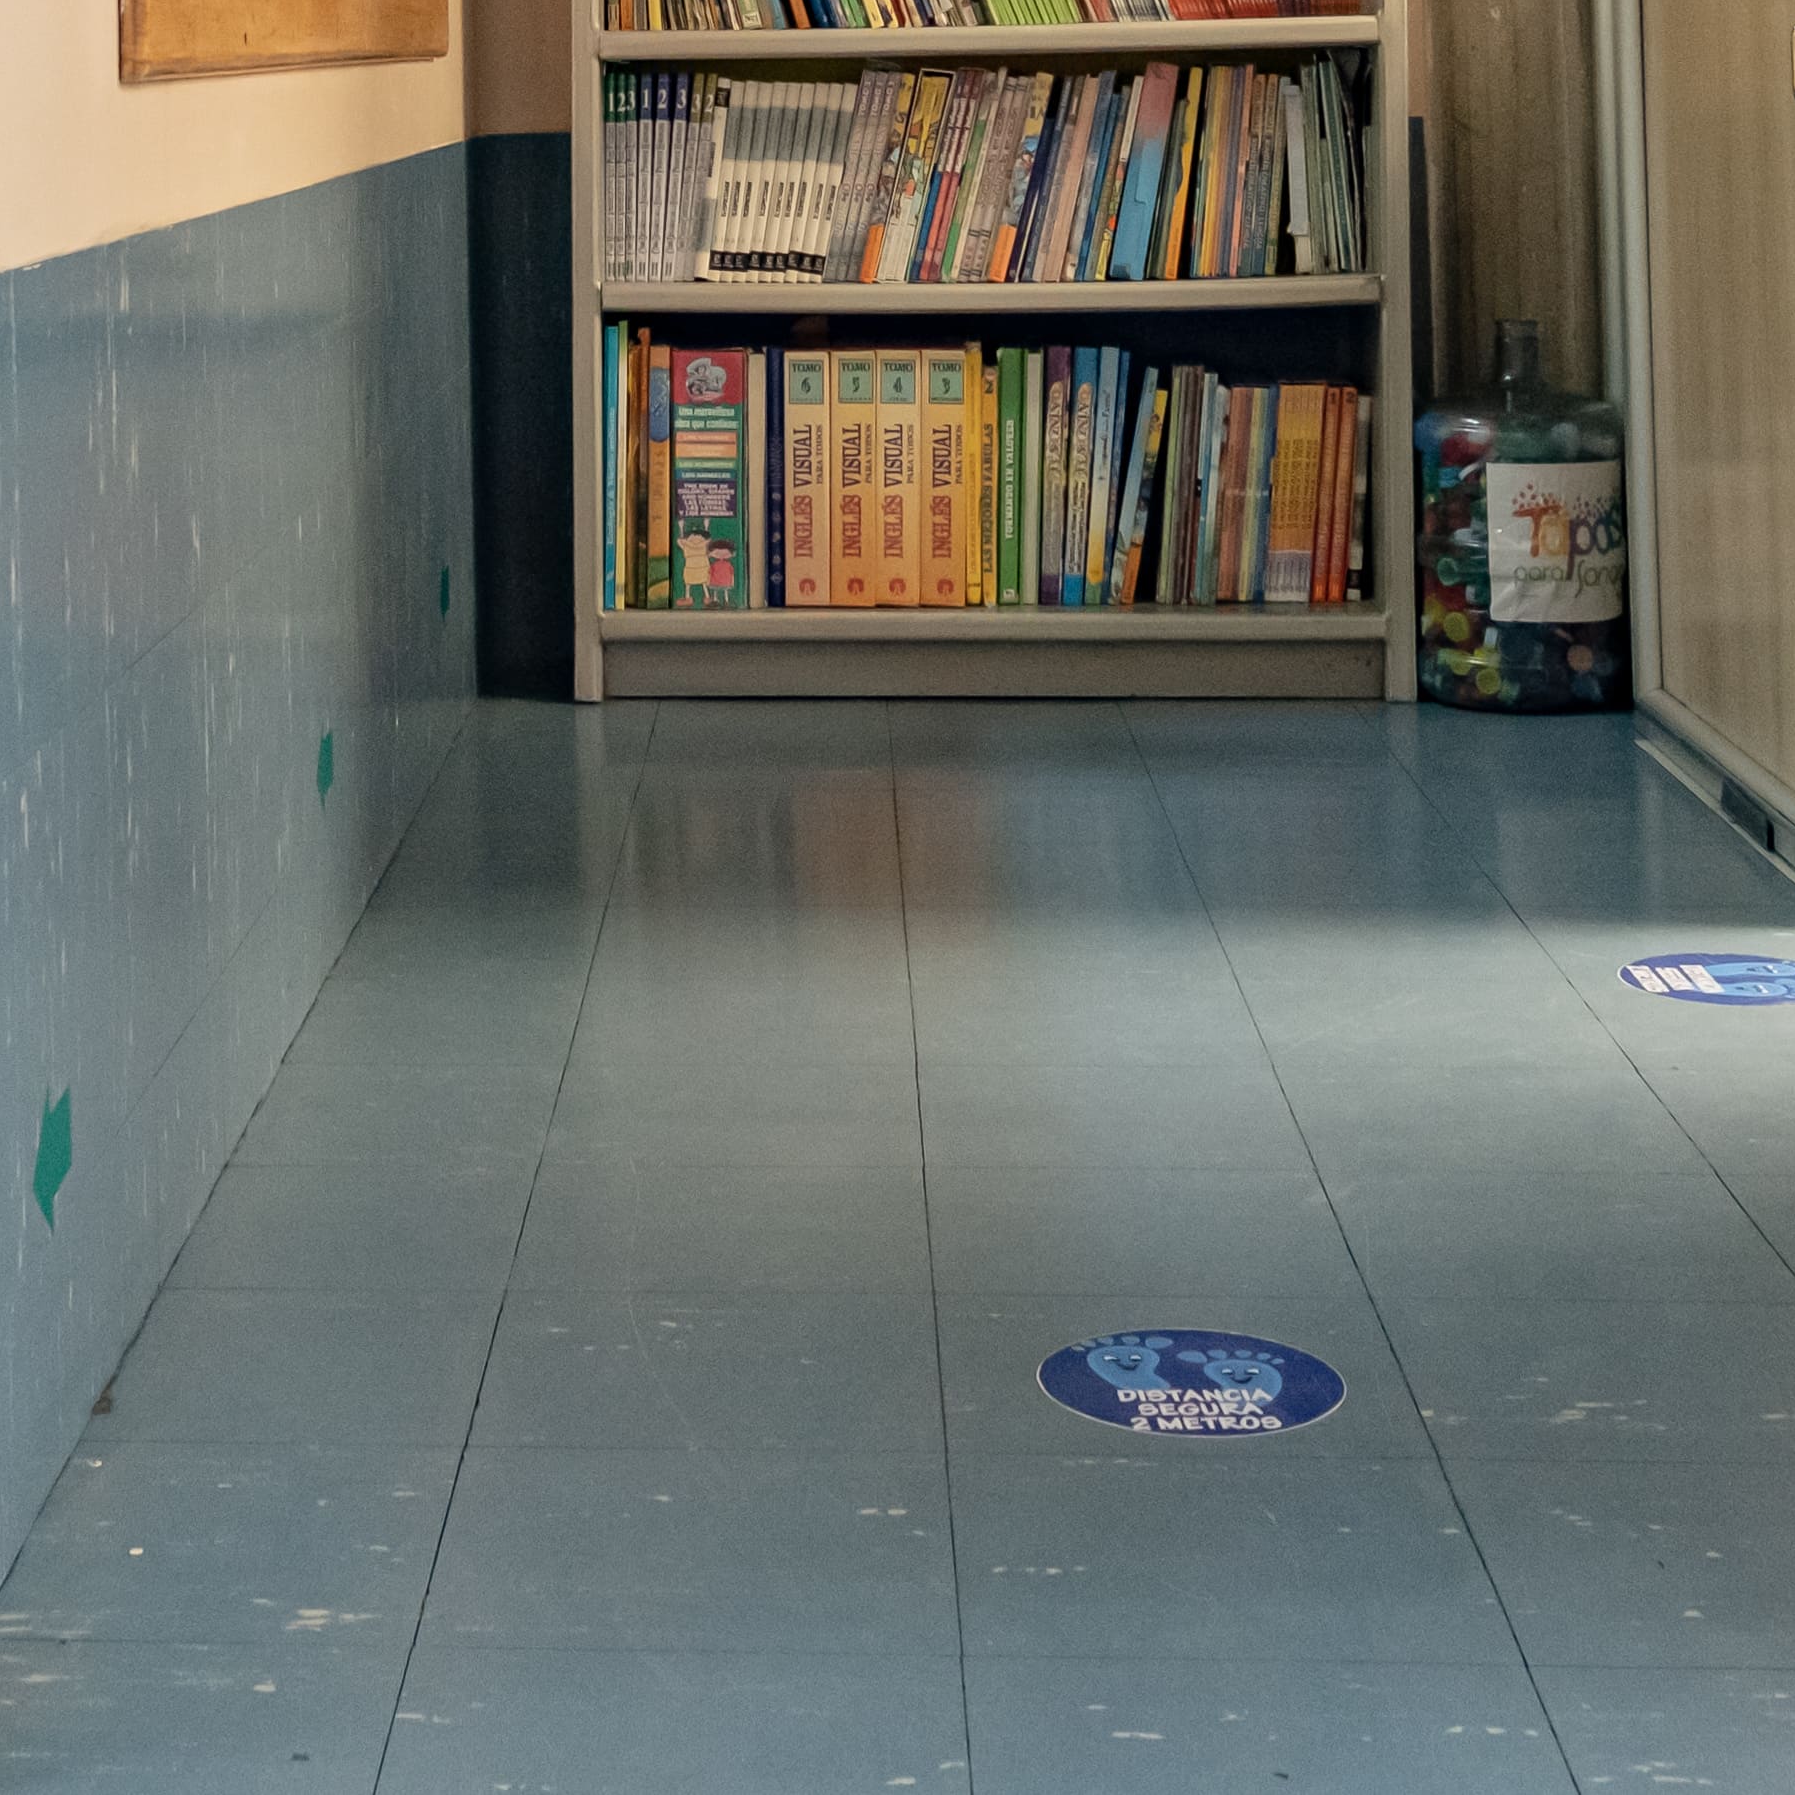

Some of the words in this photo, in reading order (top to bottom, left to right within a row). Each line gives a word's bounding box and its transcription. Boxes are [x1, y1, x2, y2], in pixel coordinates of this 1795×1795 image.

[658, 89, 667, 109] 2
[677, 89, 686, 109] 3
[792, 362, 821, 373] TOMO
[842, 362, 870, 373] TOMO
[884, 362, 913, 373] TOMO
[932, 362, 961, 373] TOMO
[793, 423, 812, 488] VISUAL
[842, 423, 861, 488] VISUAL
[884, 423, 903, 488] VISUAL
[932, 423, 951, 488] VISUAL
[1006, 467, 1014, 481] EN
[982, 485, 993, 545] MEJORES
[1006, 484, 1015, 539] FORMANDO
[791, 494, 813, 559] INGLÉS
[840, 494, 862, 559] INGLÉS
[881, 494, 903, 559] INGLÉS
[930, 494, 951, 559] INGLÉS
[983, 548, 993, 573] LAS
[1117, 1388, 1273, 1402] DISTANCIA
[1138, 1402, 1264, 1416] SEGURA
[1130, 1416, 1152, 1431] 2
[1158, 1416, 1283, 1430] METROS
